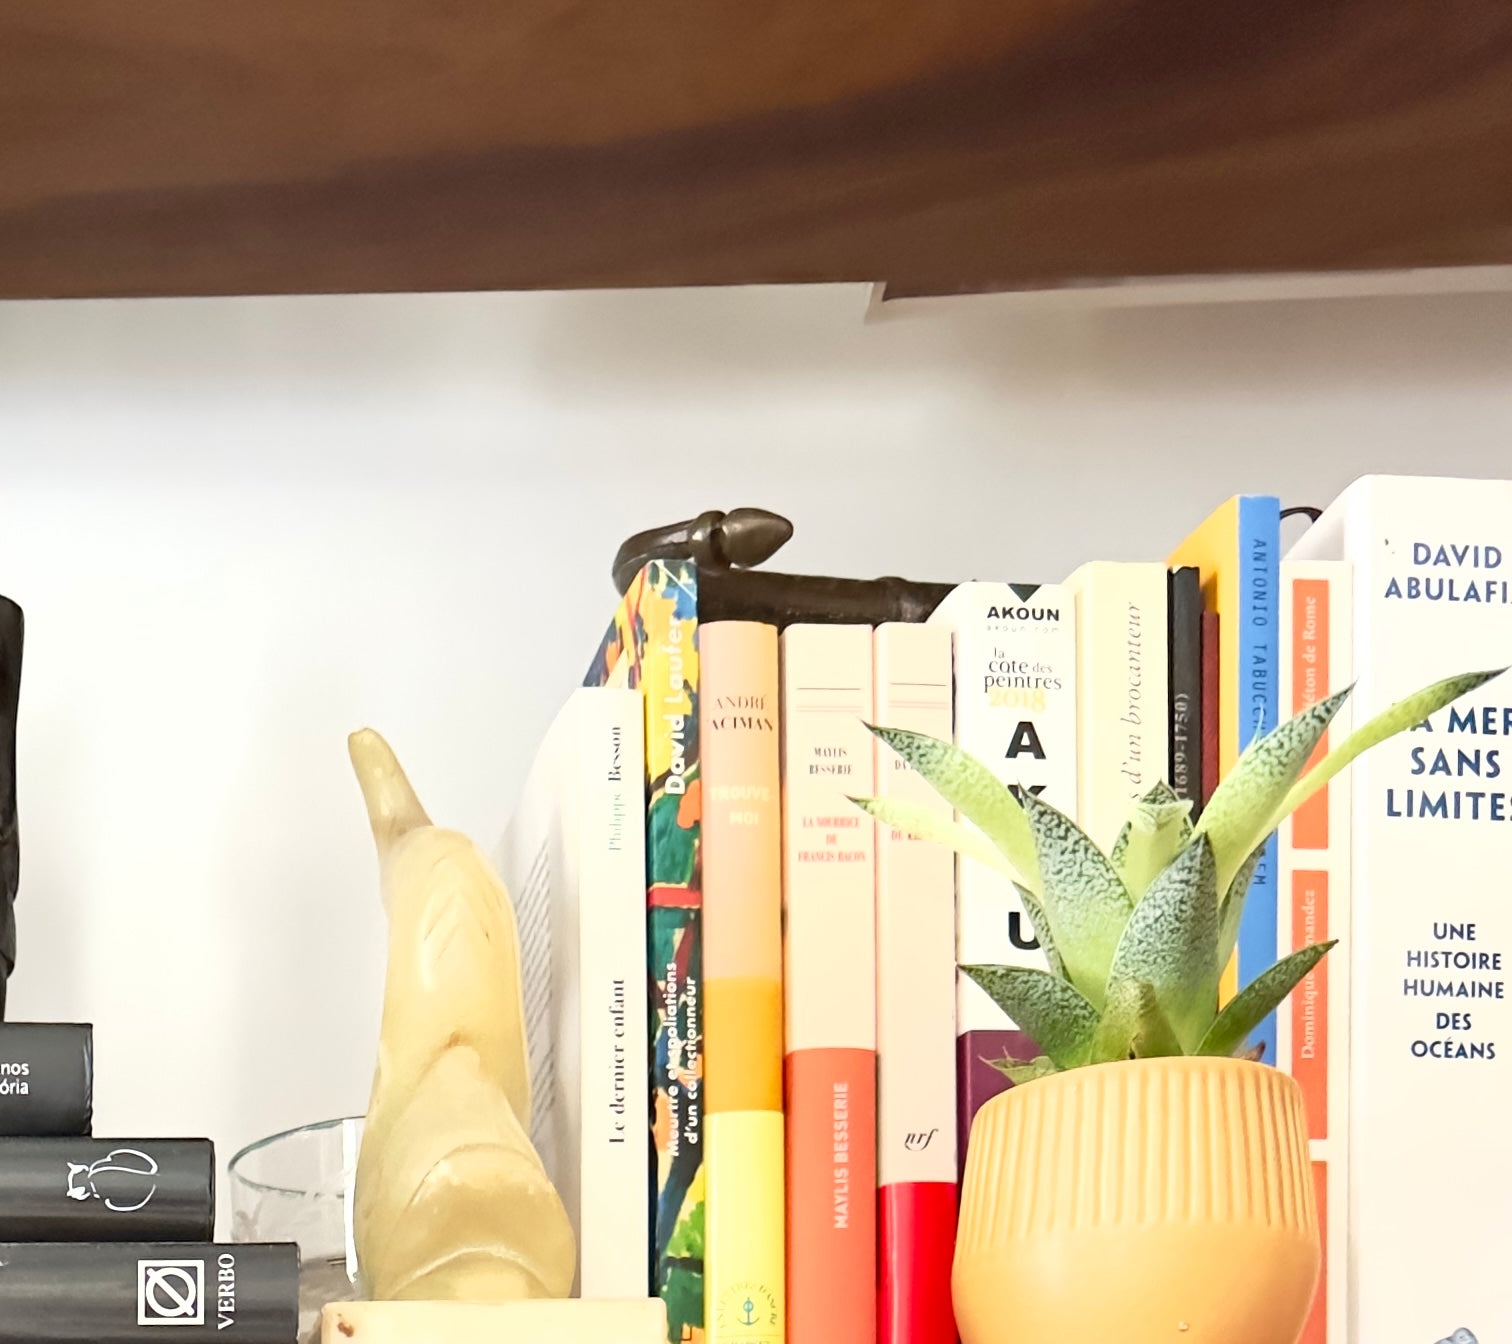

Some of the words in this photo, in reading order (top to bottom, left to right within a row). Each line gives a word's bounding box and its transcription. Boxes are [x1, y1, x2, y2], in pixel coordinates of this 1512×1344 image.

[1413, 542, 1502, 569] DAVID
[1252, 538, 1268, 627] ANTONIO
[1384, 577, 1512, 604] ABULAFI
[987, 605, 1059, 622] AKOUN
[1301, 595, 1317, 641] Rome
[994, 647, 1005, 659] la
[1032, 661, 1053, 673] des
[1301, 645, 1317, 663] de
[984, 675, 1062, 693] peintres
[608, 726, 622, 781] Besson
[663, 714, 686, 795] David
[1411, 747, 1501, 778] SANS
[1387, 789, 1512, 822] LIMITE
[1433, 922, 1476, 941] UNE
[1407, 950, 1502, 970] HISTOIRE
[1404, 979, 1504, 999] HUMAINE
[609, 980, 625, 1038] enfant
[1300, 972, 1318, 1060] Dominique
[1436, 1012, 1472, 1031] DES
[685, 977, 698, 1100] collectionneur
[1411, 1037, 1496, 1060] OCÉANS
[609, 1044, 625, 1115] dernier
[609, 1121, 625, 1143] Le
[683, 1104, 698, 1144] d'un
[833, 1082, 849, 1163] BESSERIE
[904, 1128, 939, 1151] nrf
[833, 1167, 849, 1229] MAYLIS
[217, 1253, 236, 1331] VERBO
